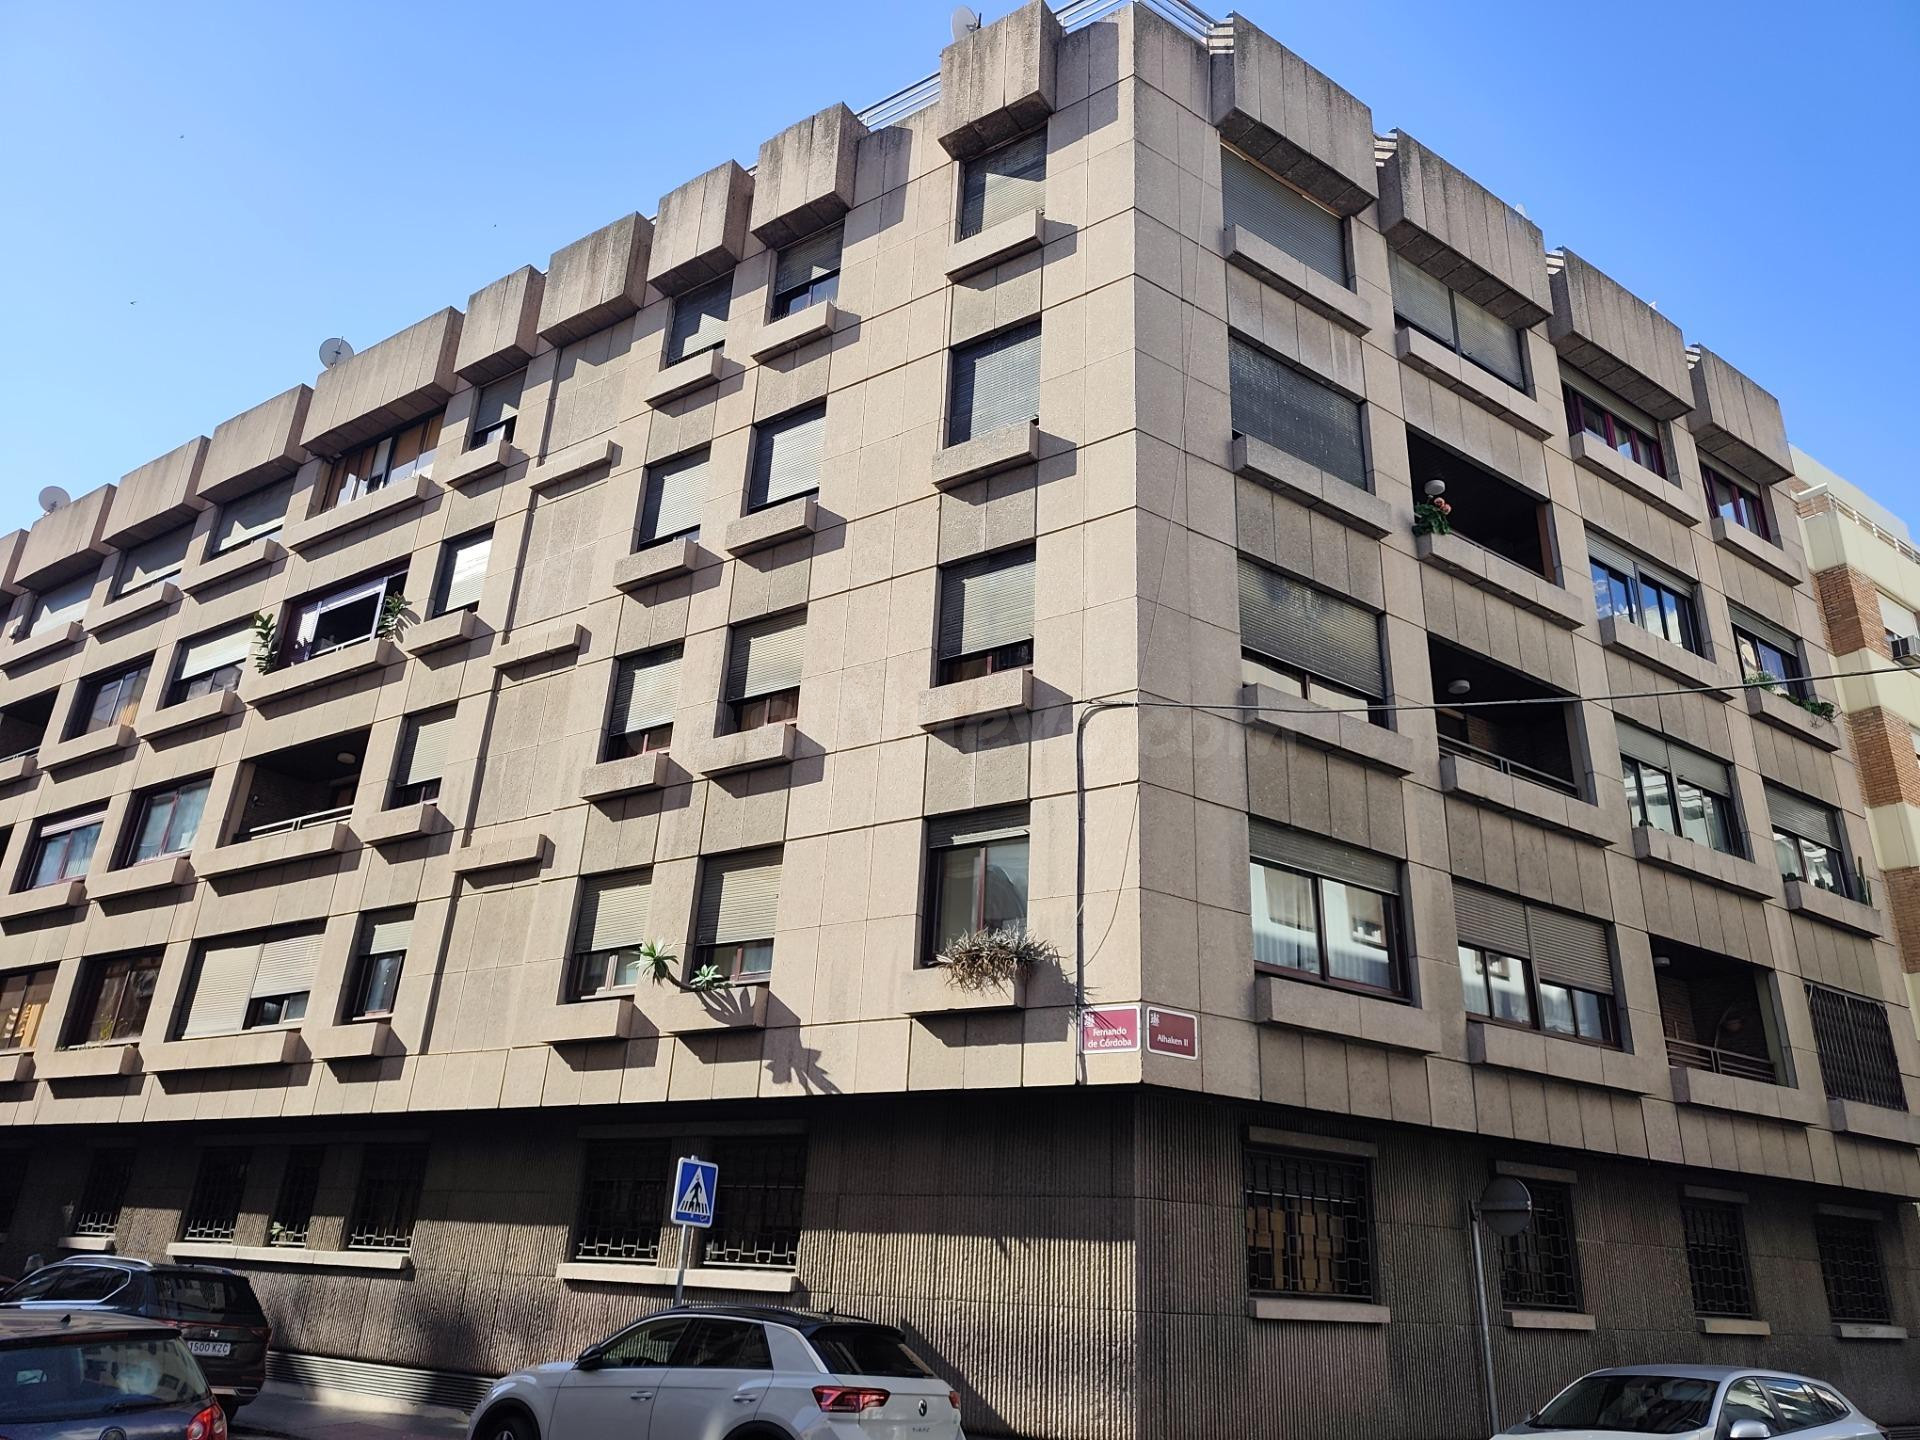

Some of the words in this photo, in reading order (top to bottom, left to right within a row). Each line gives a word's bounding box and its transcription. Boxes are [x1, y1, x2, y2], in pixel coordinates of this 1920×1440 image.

[1093, 1027, 1127, 1037] Fernando
[1088, 1040, 1098, 1048] de
[1099, 1037, 1132, 1048] Córdoba
[1157, 1034, 1182, 1046] Alhaken
[190, 1342, 210, 1352] 1500
